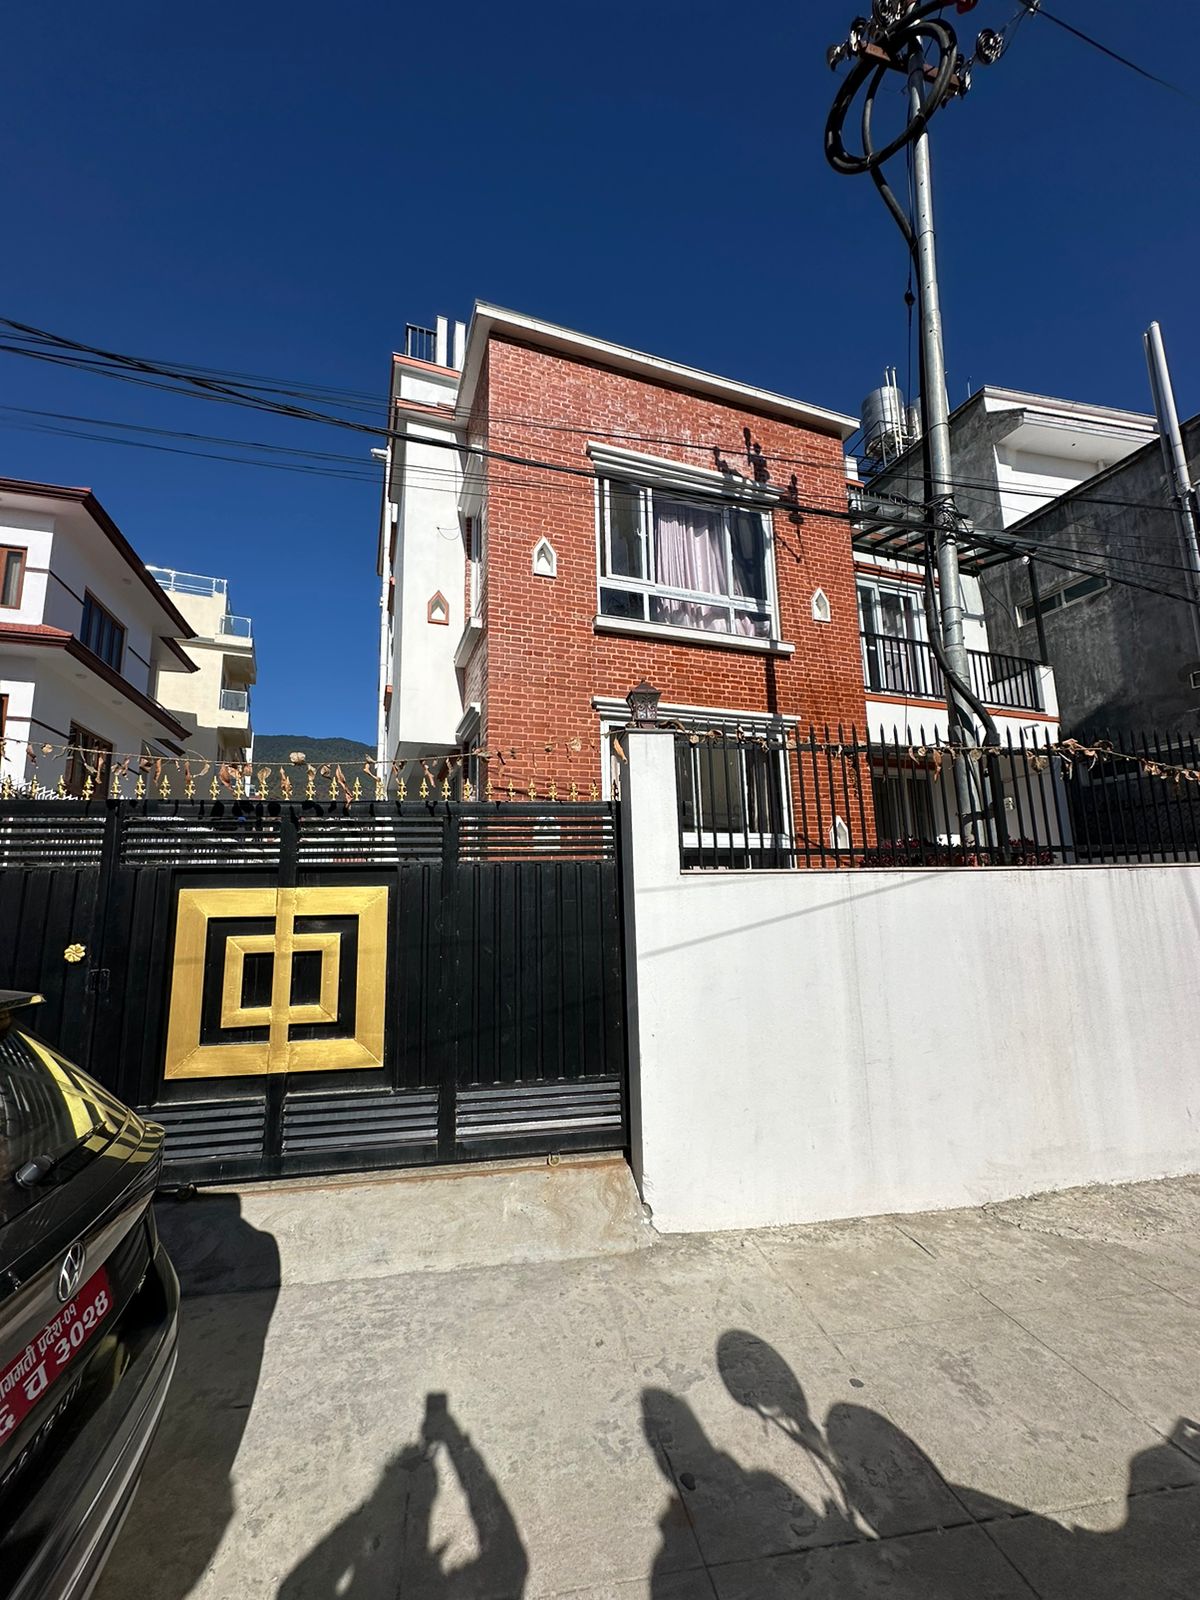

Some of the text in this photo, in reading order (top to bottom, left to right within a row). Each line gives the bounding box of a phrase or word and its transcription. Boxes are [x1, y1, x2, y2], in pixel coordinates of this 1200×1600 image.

[0, 1345, 37, 1399] ागमती
[22, 1360, 49, 1401] च
[54, 1290, 109, 1366] ३०२४
